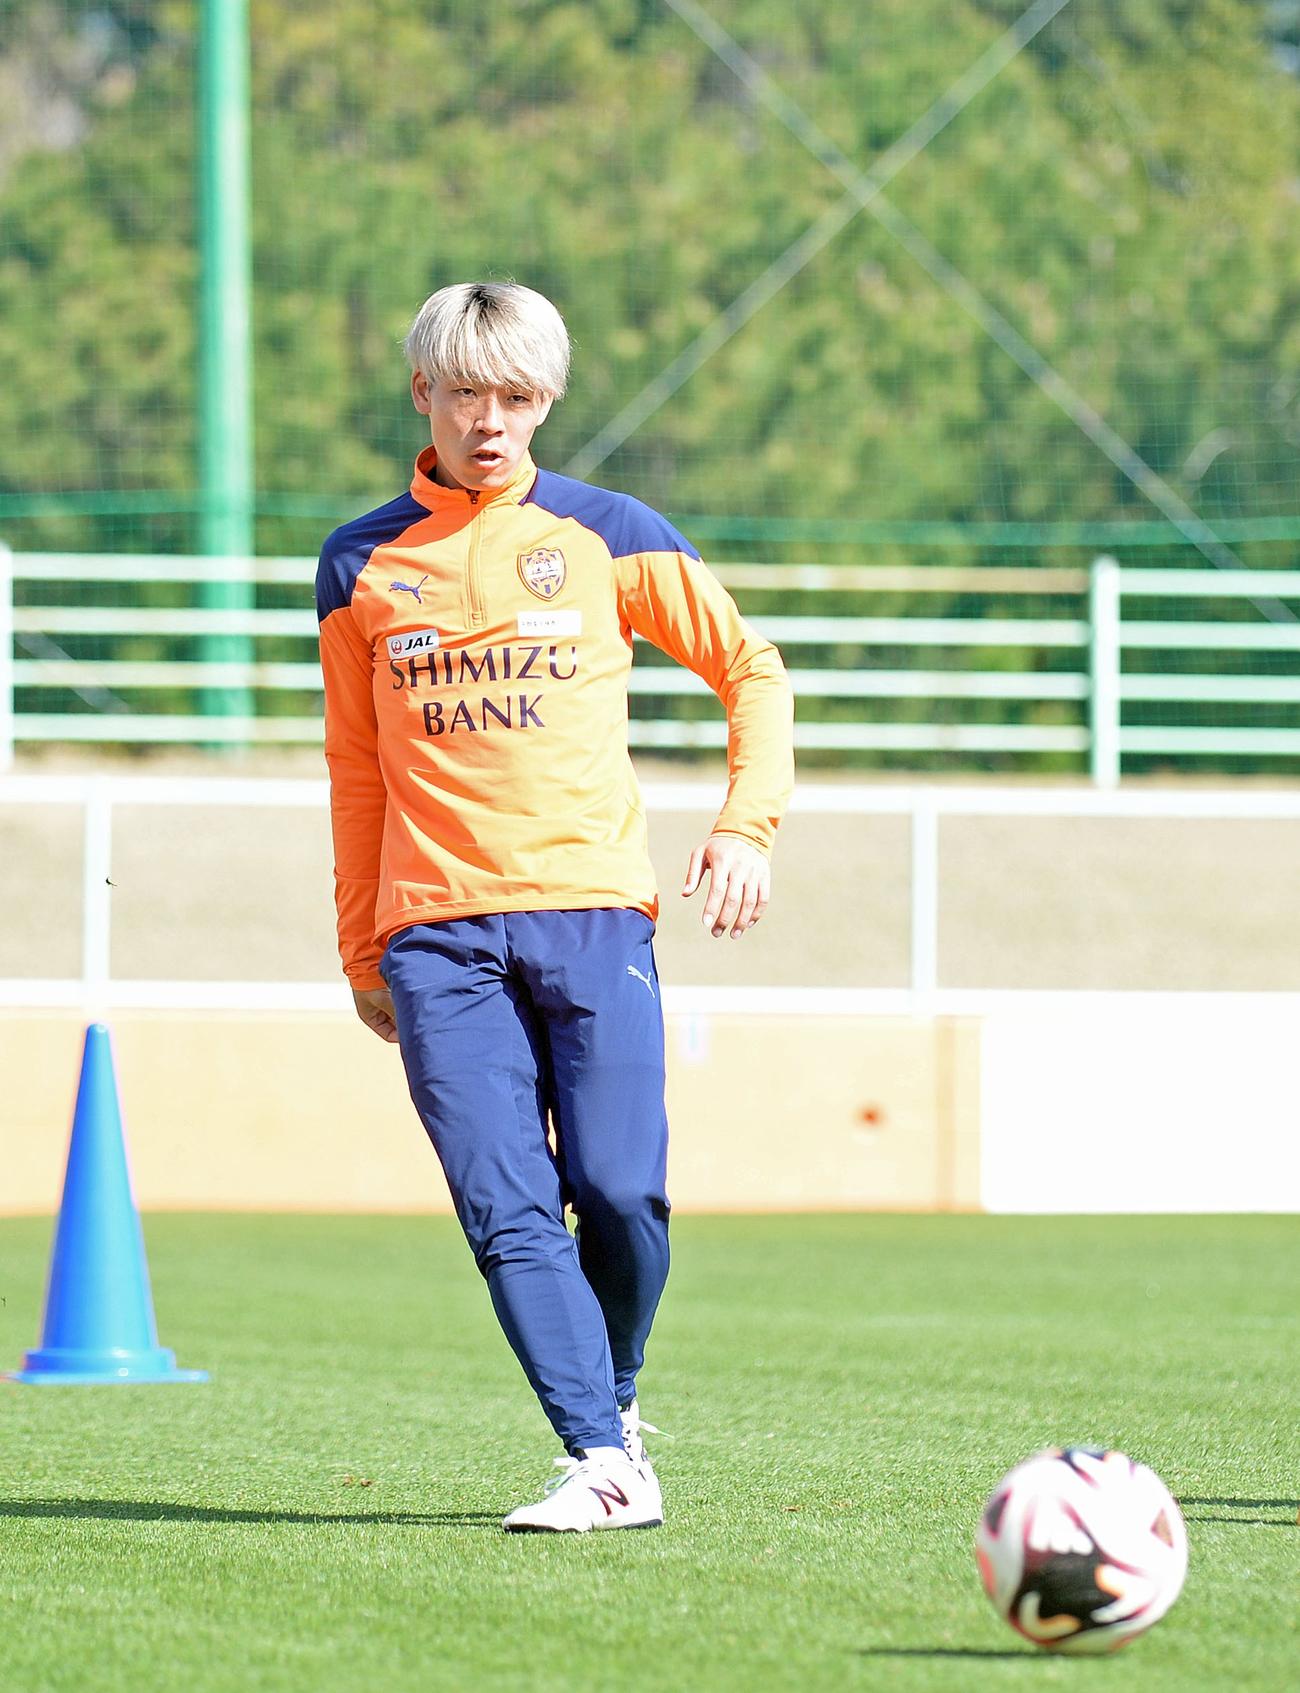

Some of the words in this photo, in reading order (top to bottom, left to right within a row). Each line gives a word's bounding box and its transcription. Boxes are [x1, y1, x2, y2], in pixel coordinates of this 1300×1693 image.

[405, 635, 433, 650] JAL
[390, 646, 576, 690] SHIMIZU
[423, 694, 545, 736] BANK
[589, 1479, 629, 1516] N
